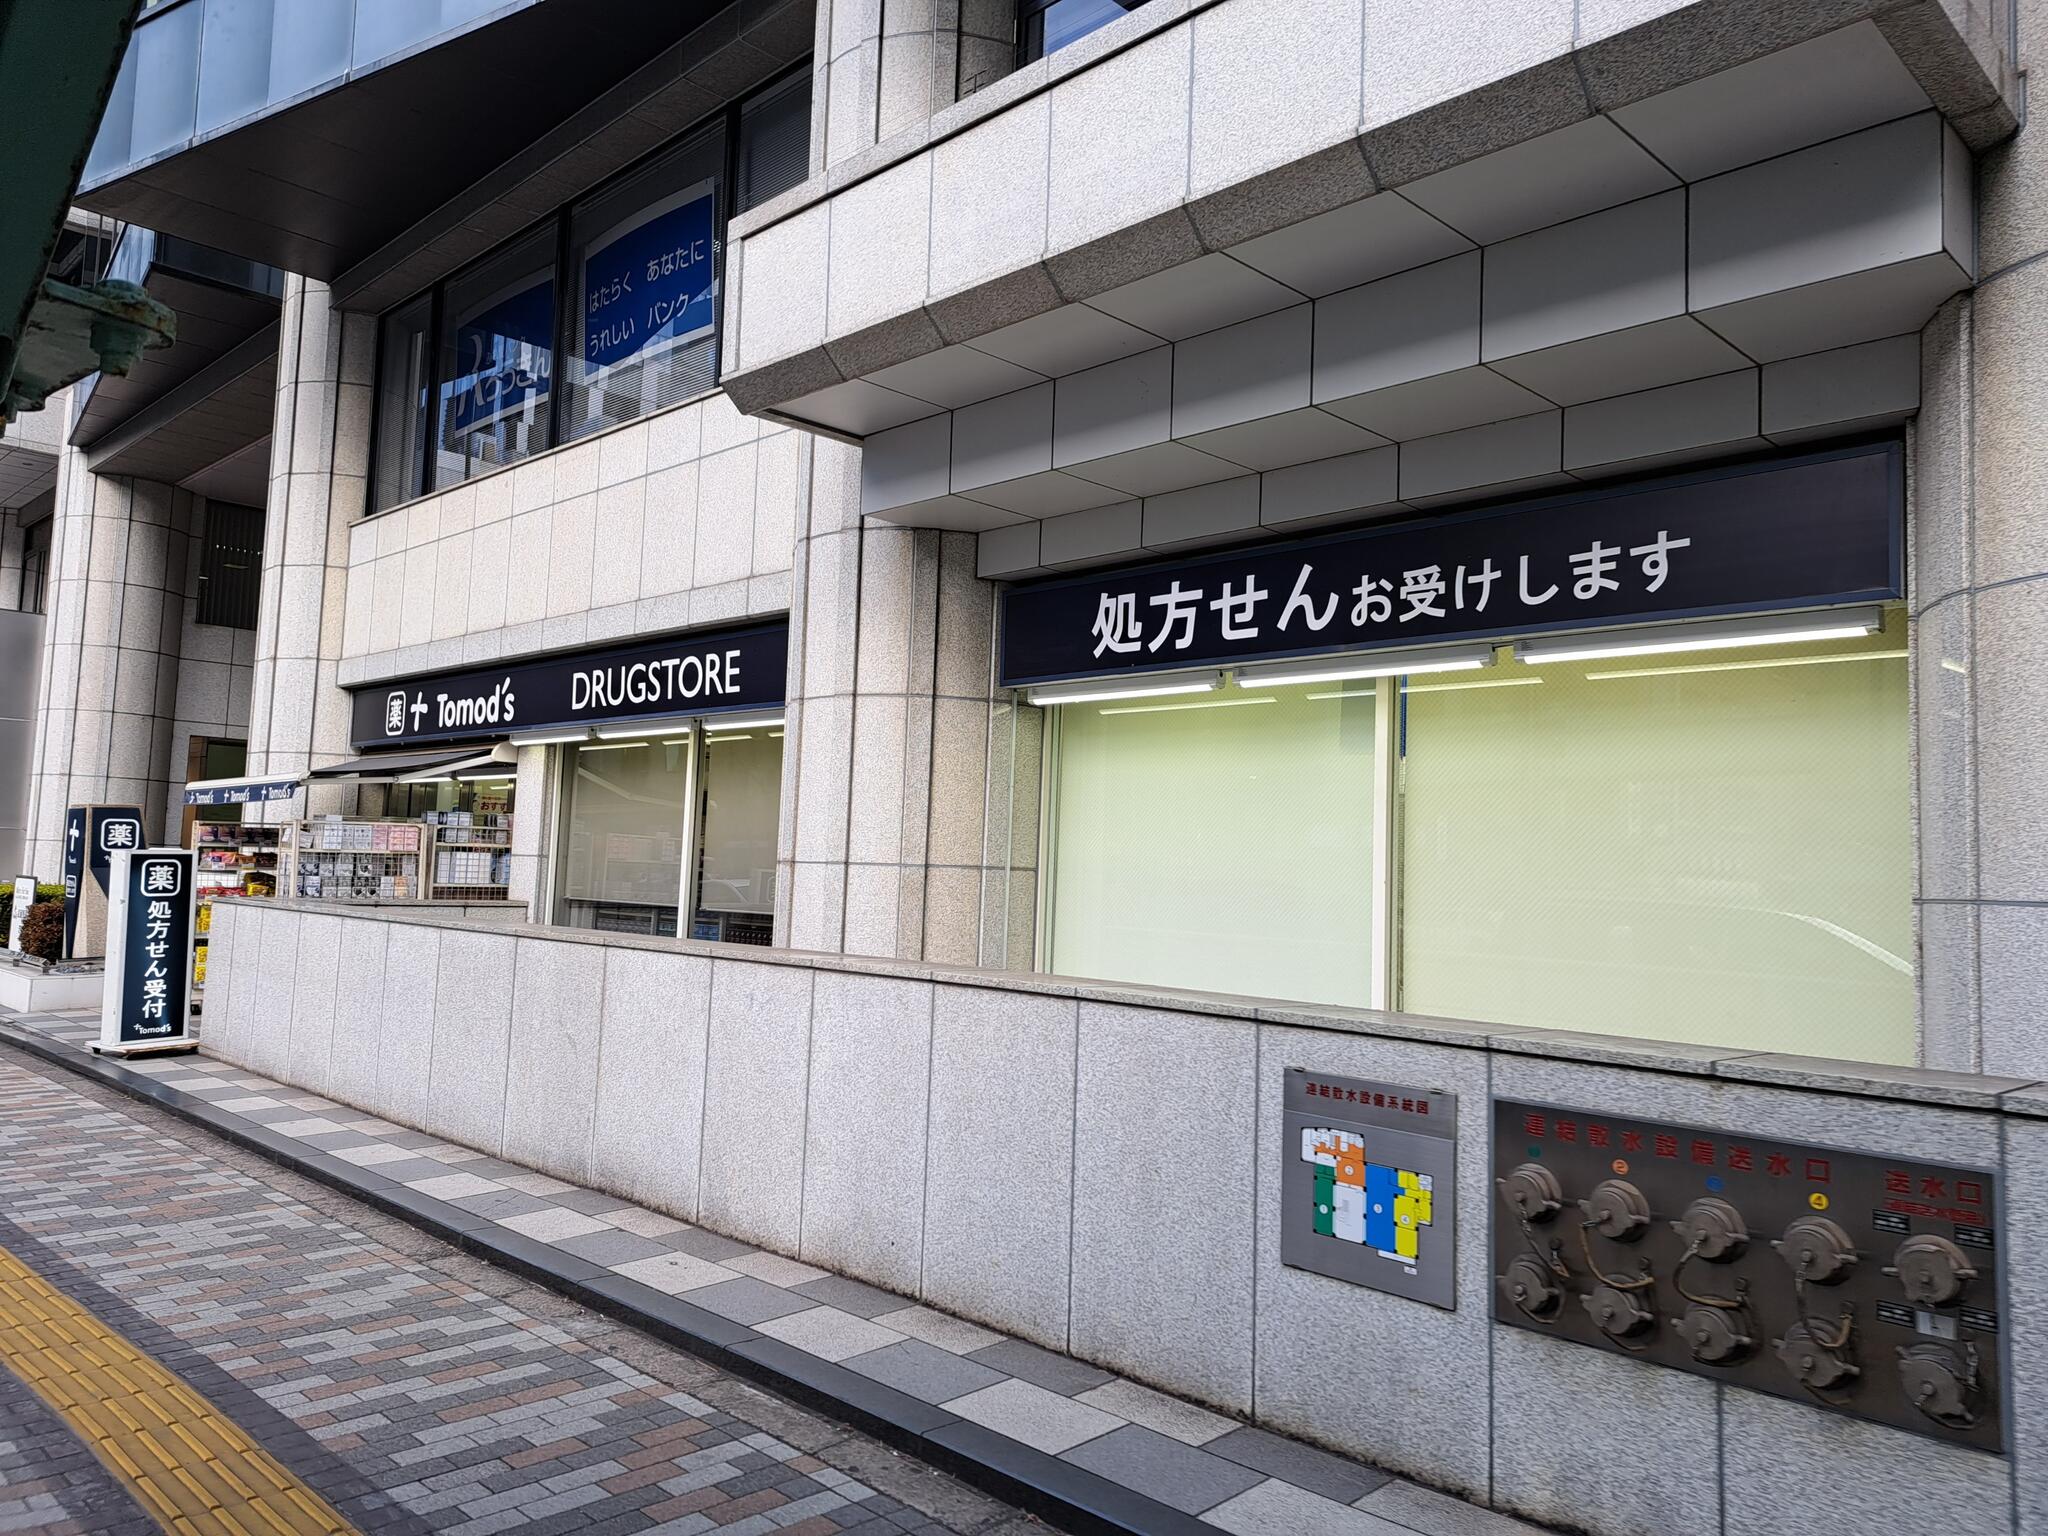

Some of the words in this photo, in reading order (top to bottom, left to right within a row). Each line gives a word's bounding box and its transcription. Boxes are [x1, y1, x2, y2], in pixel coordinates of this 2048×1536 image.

[589, 271, 633, 314] はたらく
[646, 239, 705, 282] あなたに
[589, 317, 635, 357] うれしい
[647, 292, 690, 329] バンク
[1091, 530, 1692, 659] 処方せんお受けします
[436, 676, 515, 728] Tomod's
[571, 649, 741, 711] DRUGSTORE
[267, 783, 291, 799] Tomod's
[142, 900, 172, 1019] 処方せん受付
[138, 1023, 172, 1035] Tomod's
